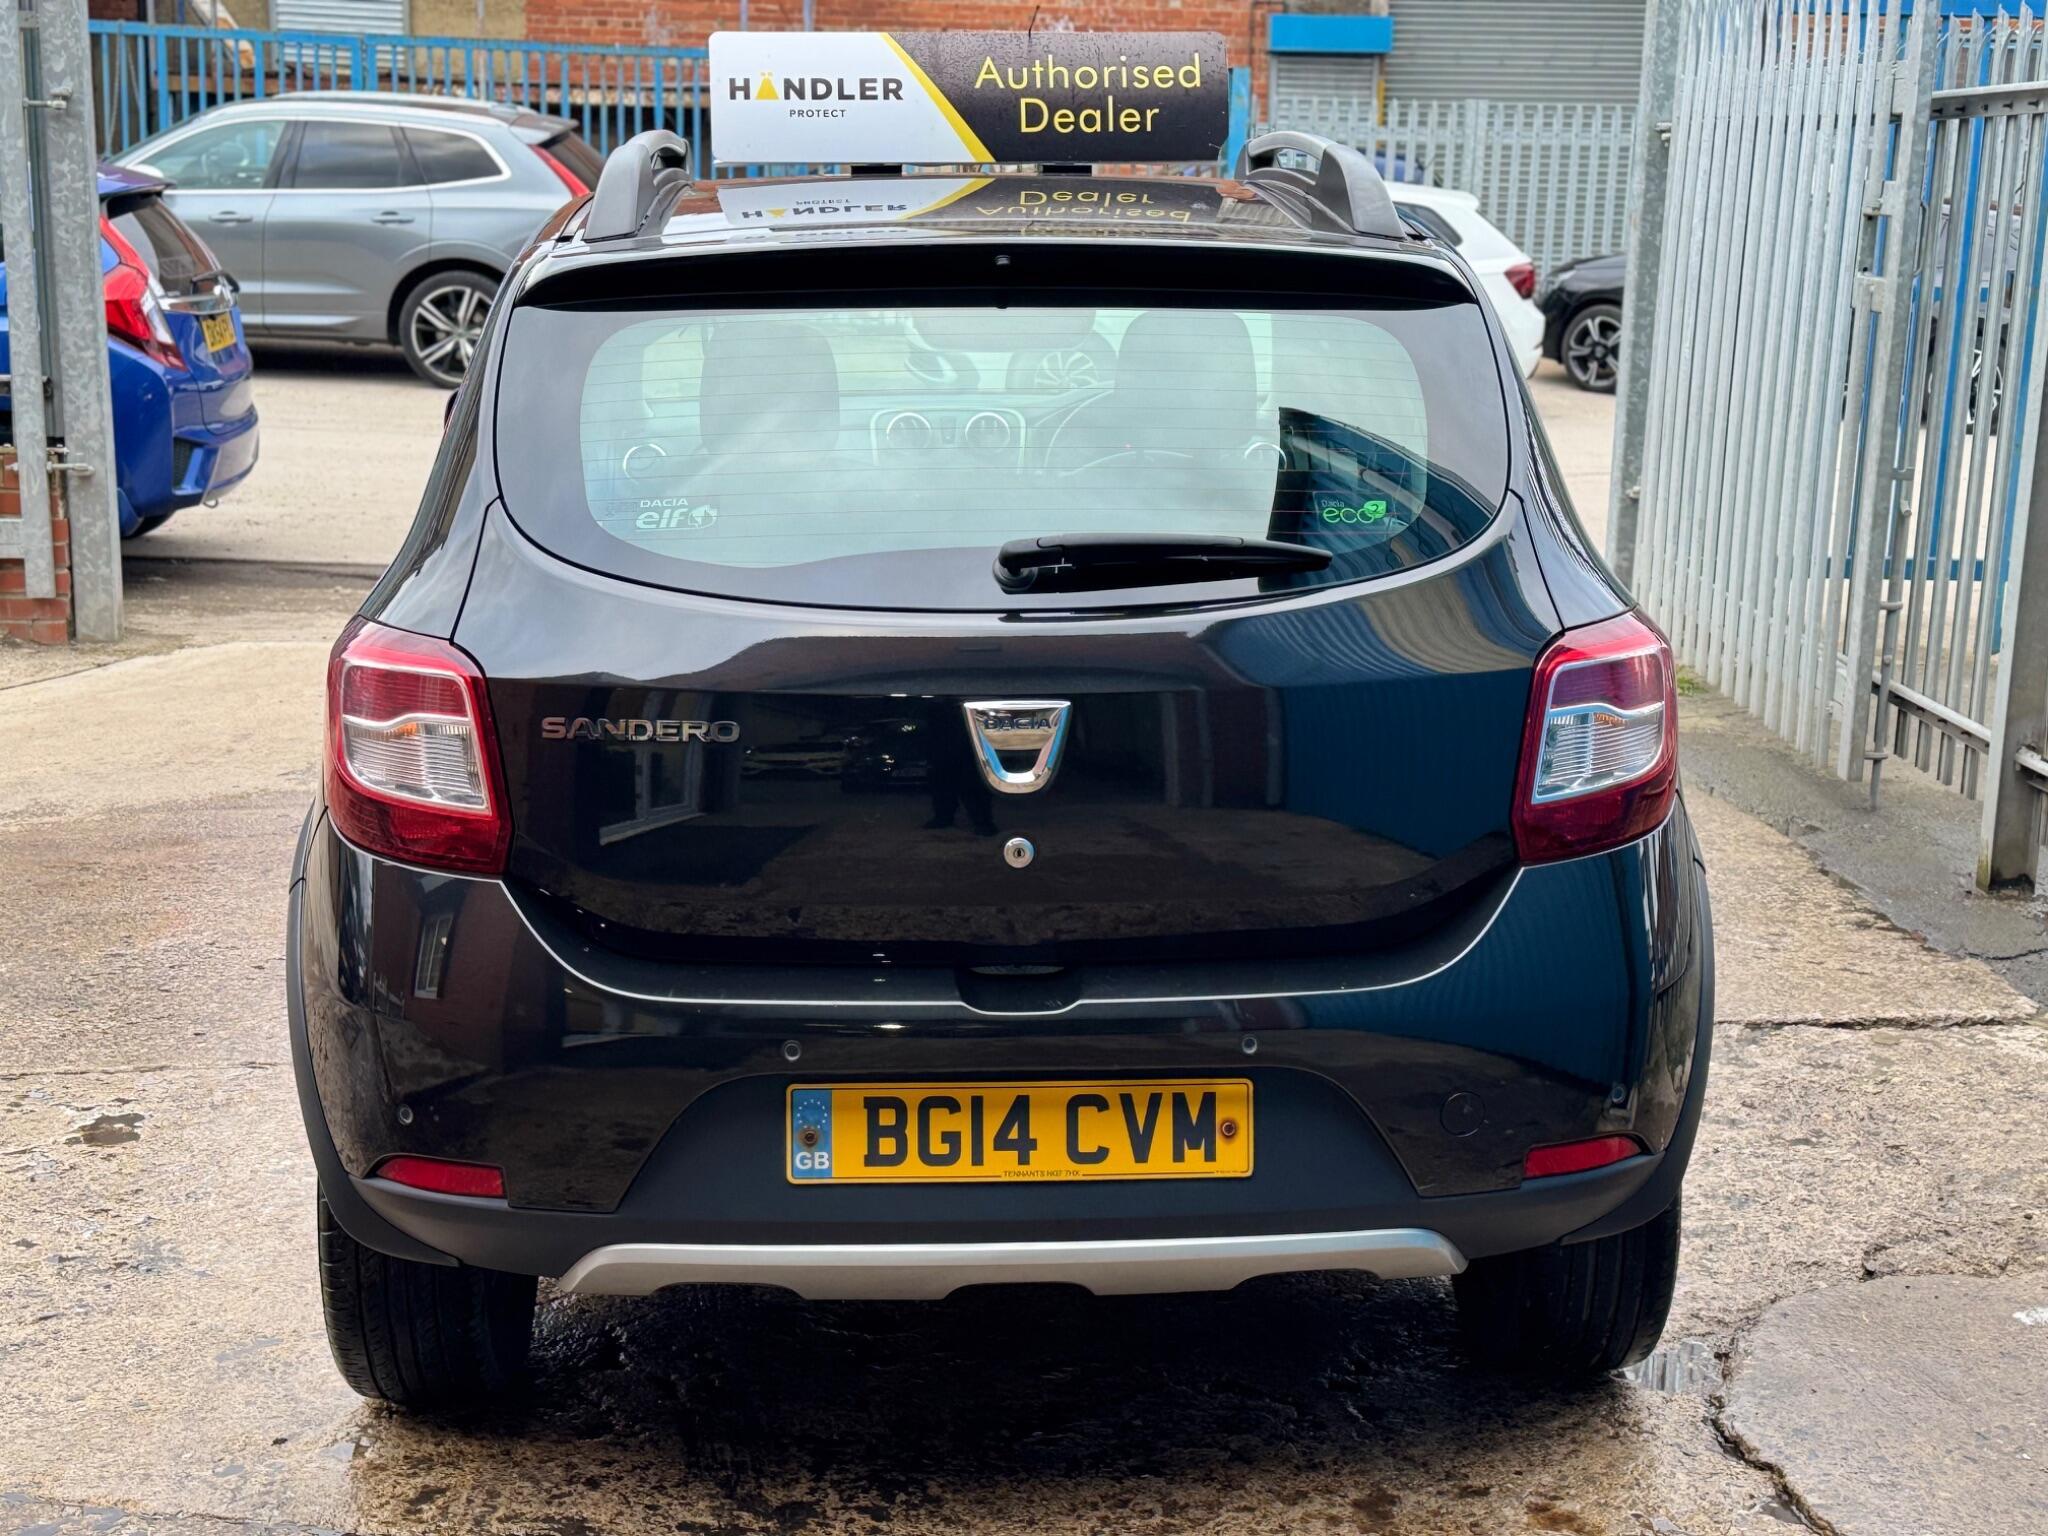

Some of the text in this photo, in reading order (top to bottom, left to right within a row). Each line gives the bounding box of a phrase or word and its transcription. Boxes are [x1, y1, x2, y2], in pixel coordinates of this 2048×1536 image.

[974, 53, 1202, 90] Authorised
[789, 109, 847, 118] PROTECT
[1020, 97, 1160, 134] Dealer
[640, 498, 689, 508] DACIA
[635, 508, 689, 529] elf
[541, 716, 741, 743] SANDERO
[984, 718, 1052, 730] DACIA
[863, 1091, 1218, 1168] BG14 CVM
[794, 1151, 830, 1171] GB
